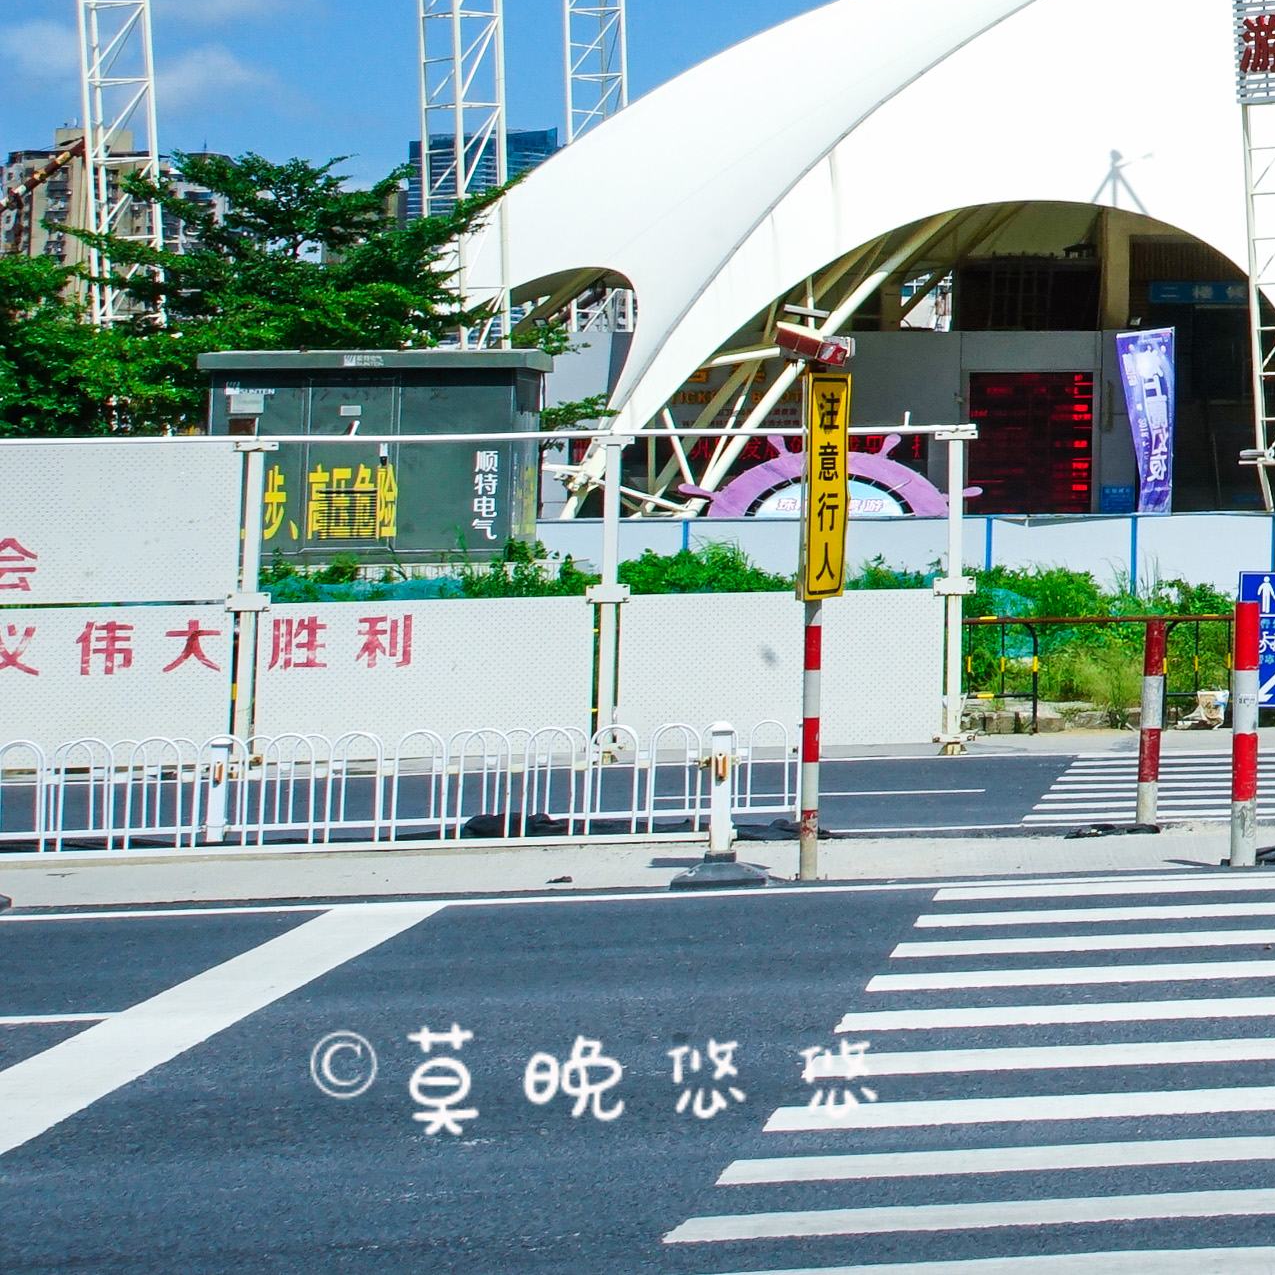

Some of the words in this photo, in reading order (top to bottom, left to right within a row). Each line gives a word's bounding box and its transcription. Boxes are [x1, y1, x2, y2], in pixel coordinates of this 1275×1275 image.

[241, 463, 397, 540] 步、高压危险
[471, 450, 498, 541] 顺特电气
[815, 392, 841, 582] 注意行人
